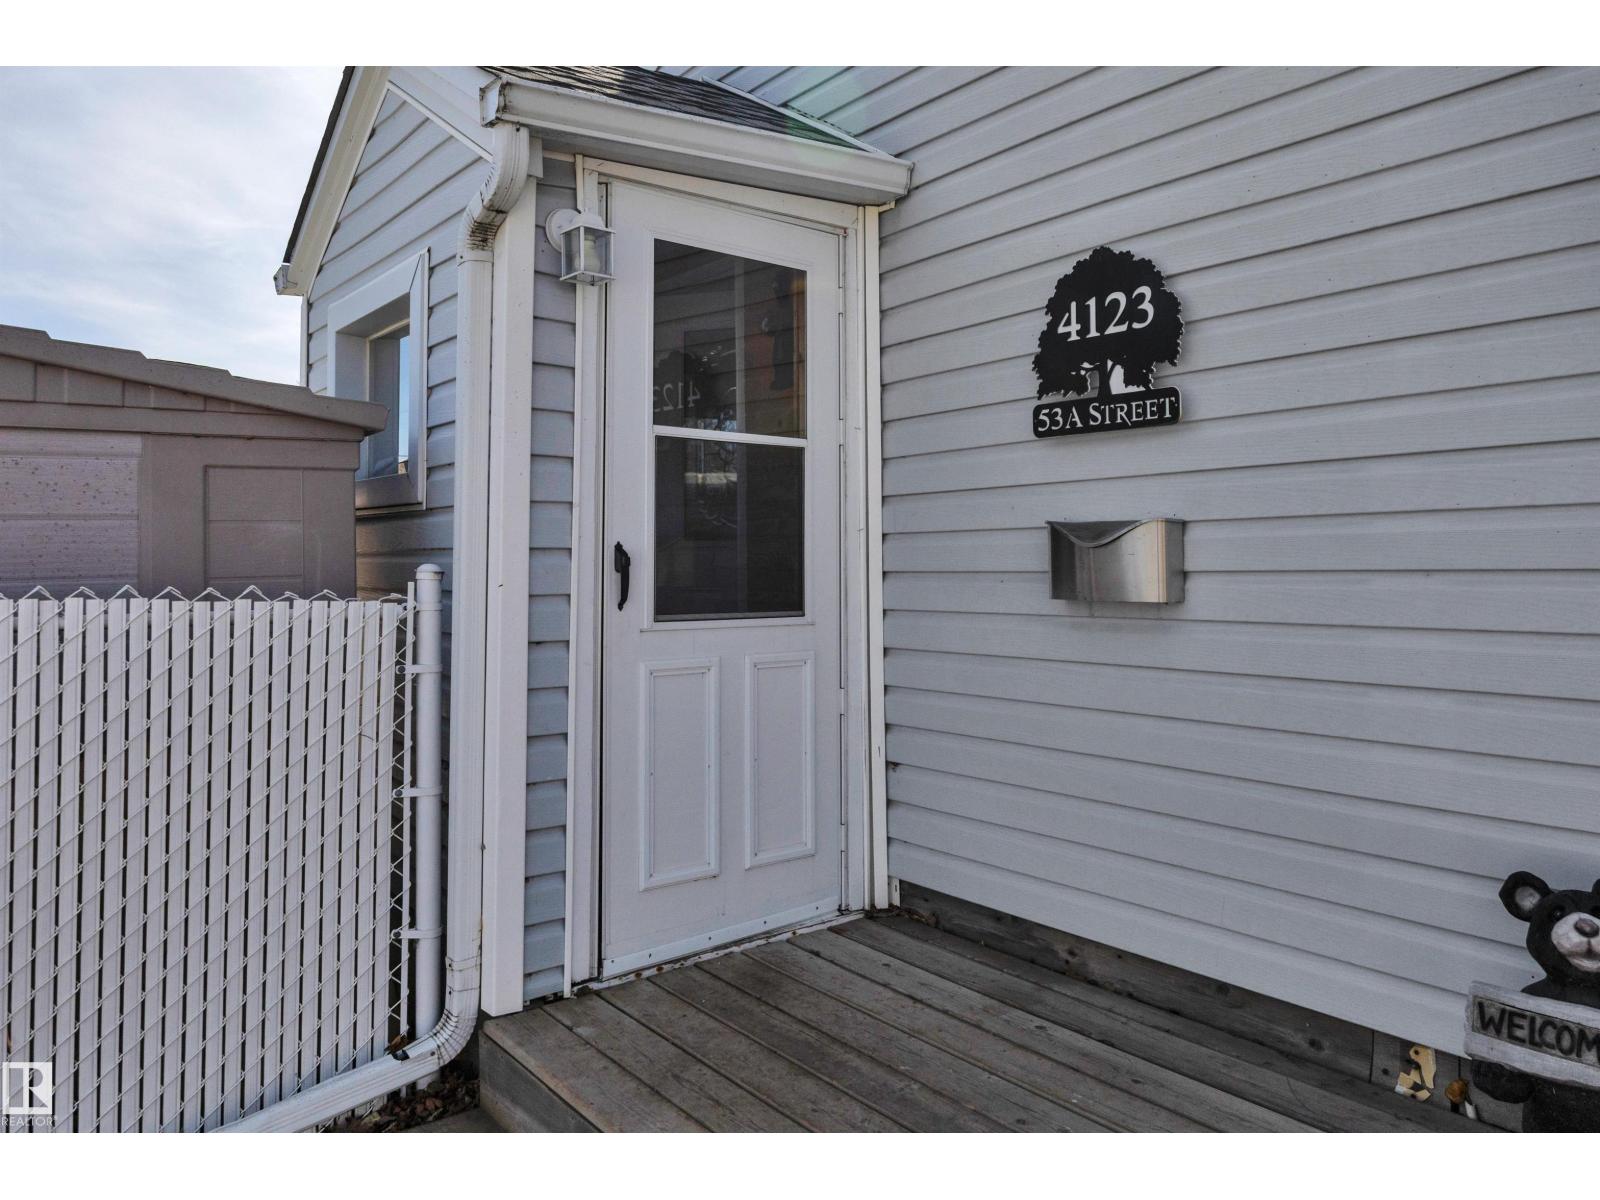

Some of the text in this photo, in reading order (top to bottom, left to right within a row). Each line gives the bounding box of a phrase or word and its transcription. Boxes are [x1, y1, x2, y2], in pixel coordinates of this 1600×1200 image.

[1057, 285, 1155, 341] 4123
[1038, 397, 1175, 432] 53A STREET
